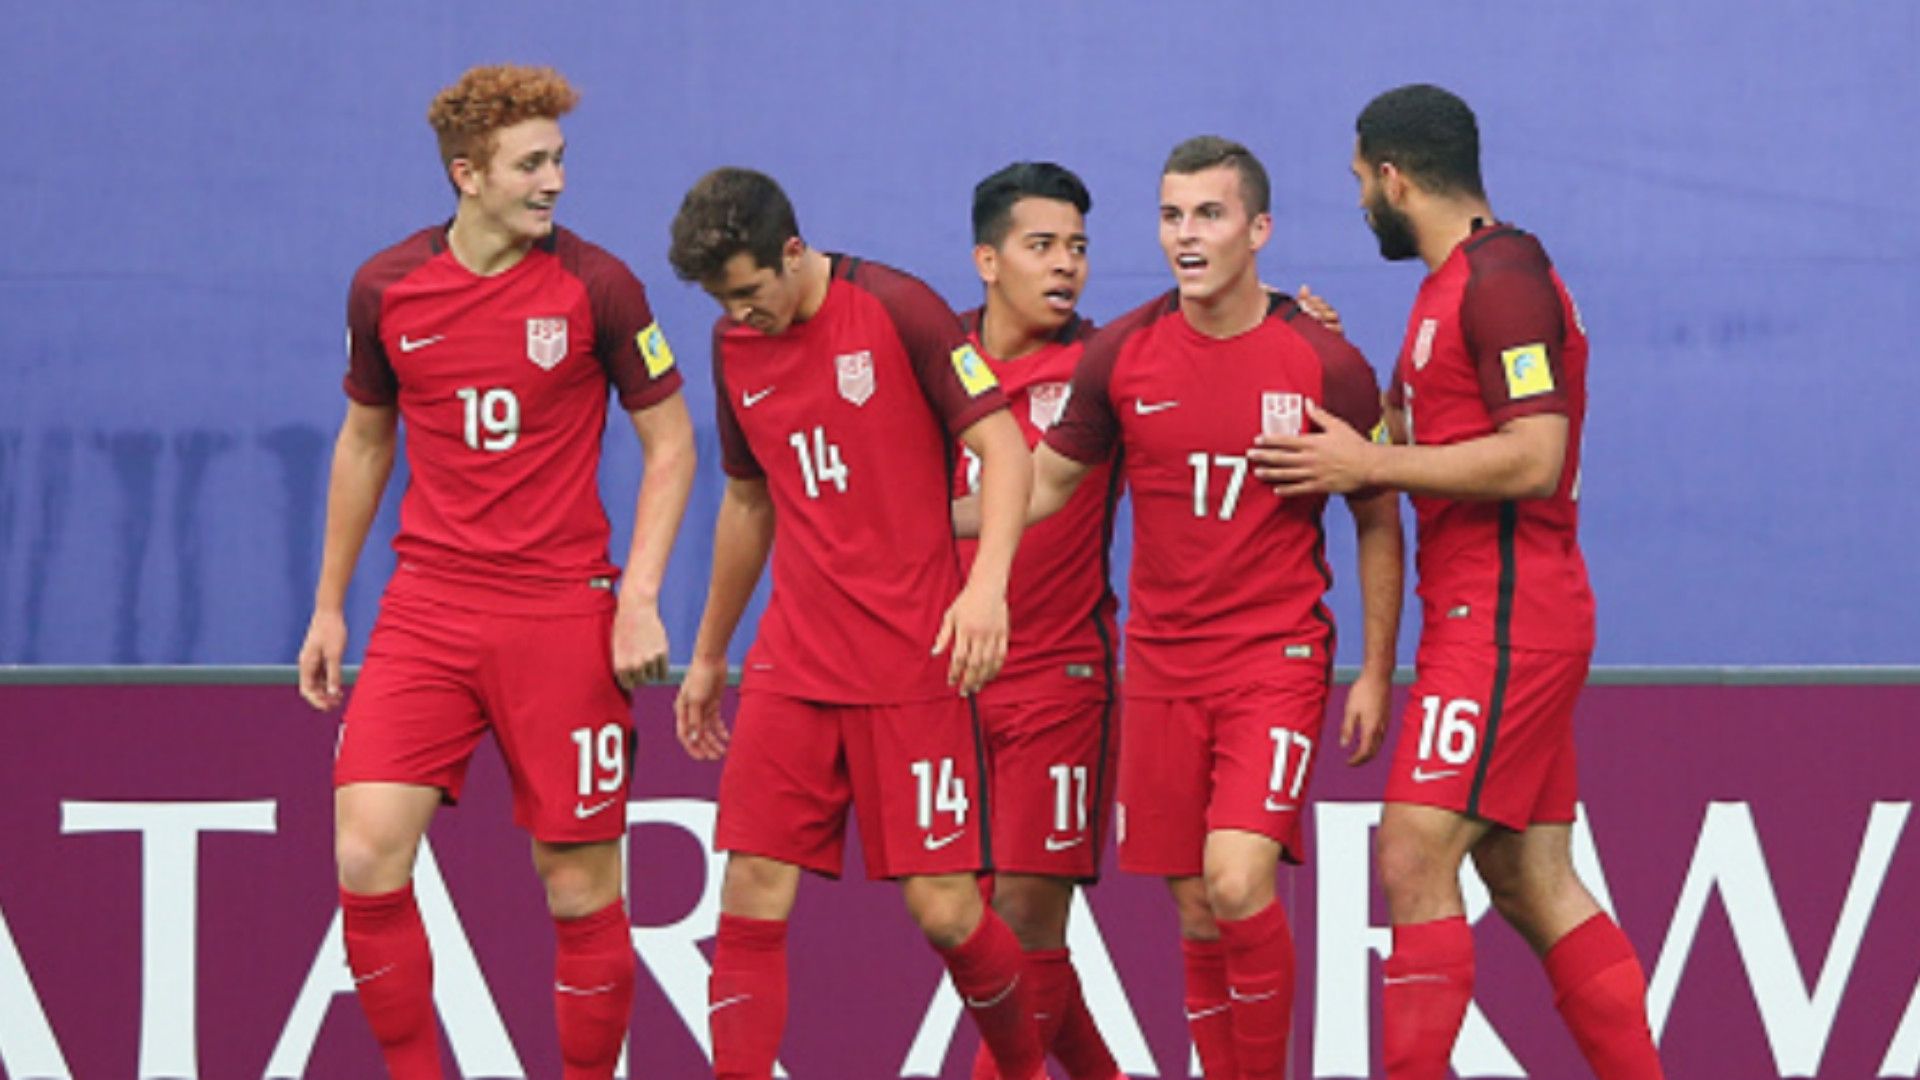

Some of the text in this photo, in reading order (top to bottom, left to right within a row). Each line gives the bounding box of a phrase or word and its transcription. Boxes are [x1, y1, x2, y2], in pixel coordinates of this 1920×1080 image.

[456, 388, 519, 451] 19
[790, 426, 848, 498] 14
[1189, 452, 1247, 520] 17
[571, 723, 624, 796] 19
[1269, 727, 1312, 799] 17
[1421, 696, 1480, 764] 16
[911, 758, 969, 829] 14
[1049, 764, 1087, 831] 11
